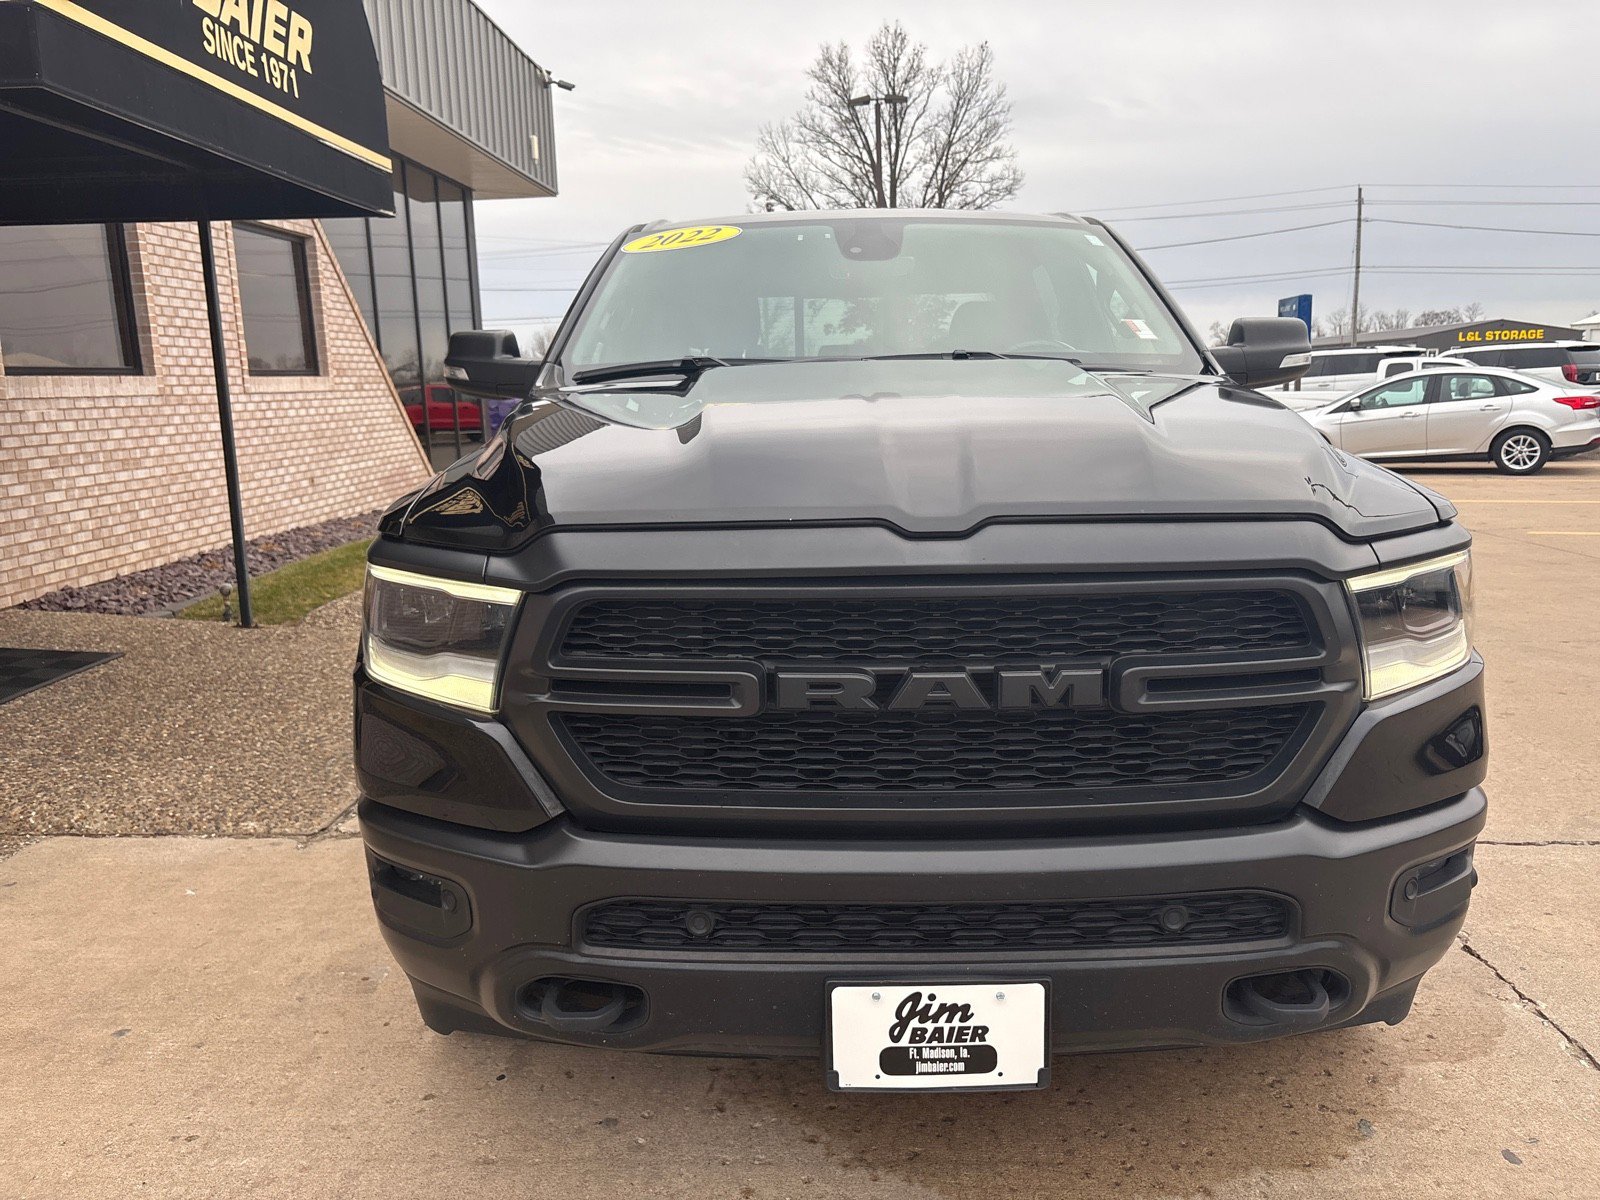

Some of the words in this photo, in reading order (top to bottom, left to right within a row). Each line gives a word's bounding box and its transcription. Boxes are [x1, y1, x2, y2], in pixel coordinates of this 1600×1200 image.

[202, 17, 259, 78] SINCE
[261, 53, 299, 99] 1971
[639, 227, 722, 250] 2022
[1458, 331, 1482, 342] L&L
[1485, 329, 1545, 341] STORAGE
[776, 669, 1104, 711] RAM
[888, 991, 975, 1044] Jim
[908, 1025, 990, 1044] BAIER
[909, 1047, 919, 1060] Ft.
[922, 1047, 957, 1060] Madison,
[915, 1061, 965, 1075] jimbaier.com
